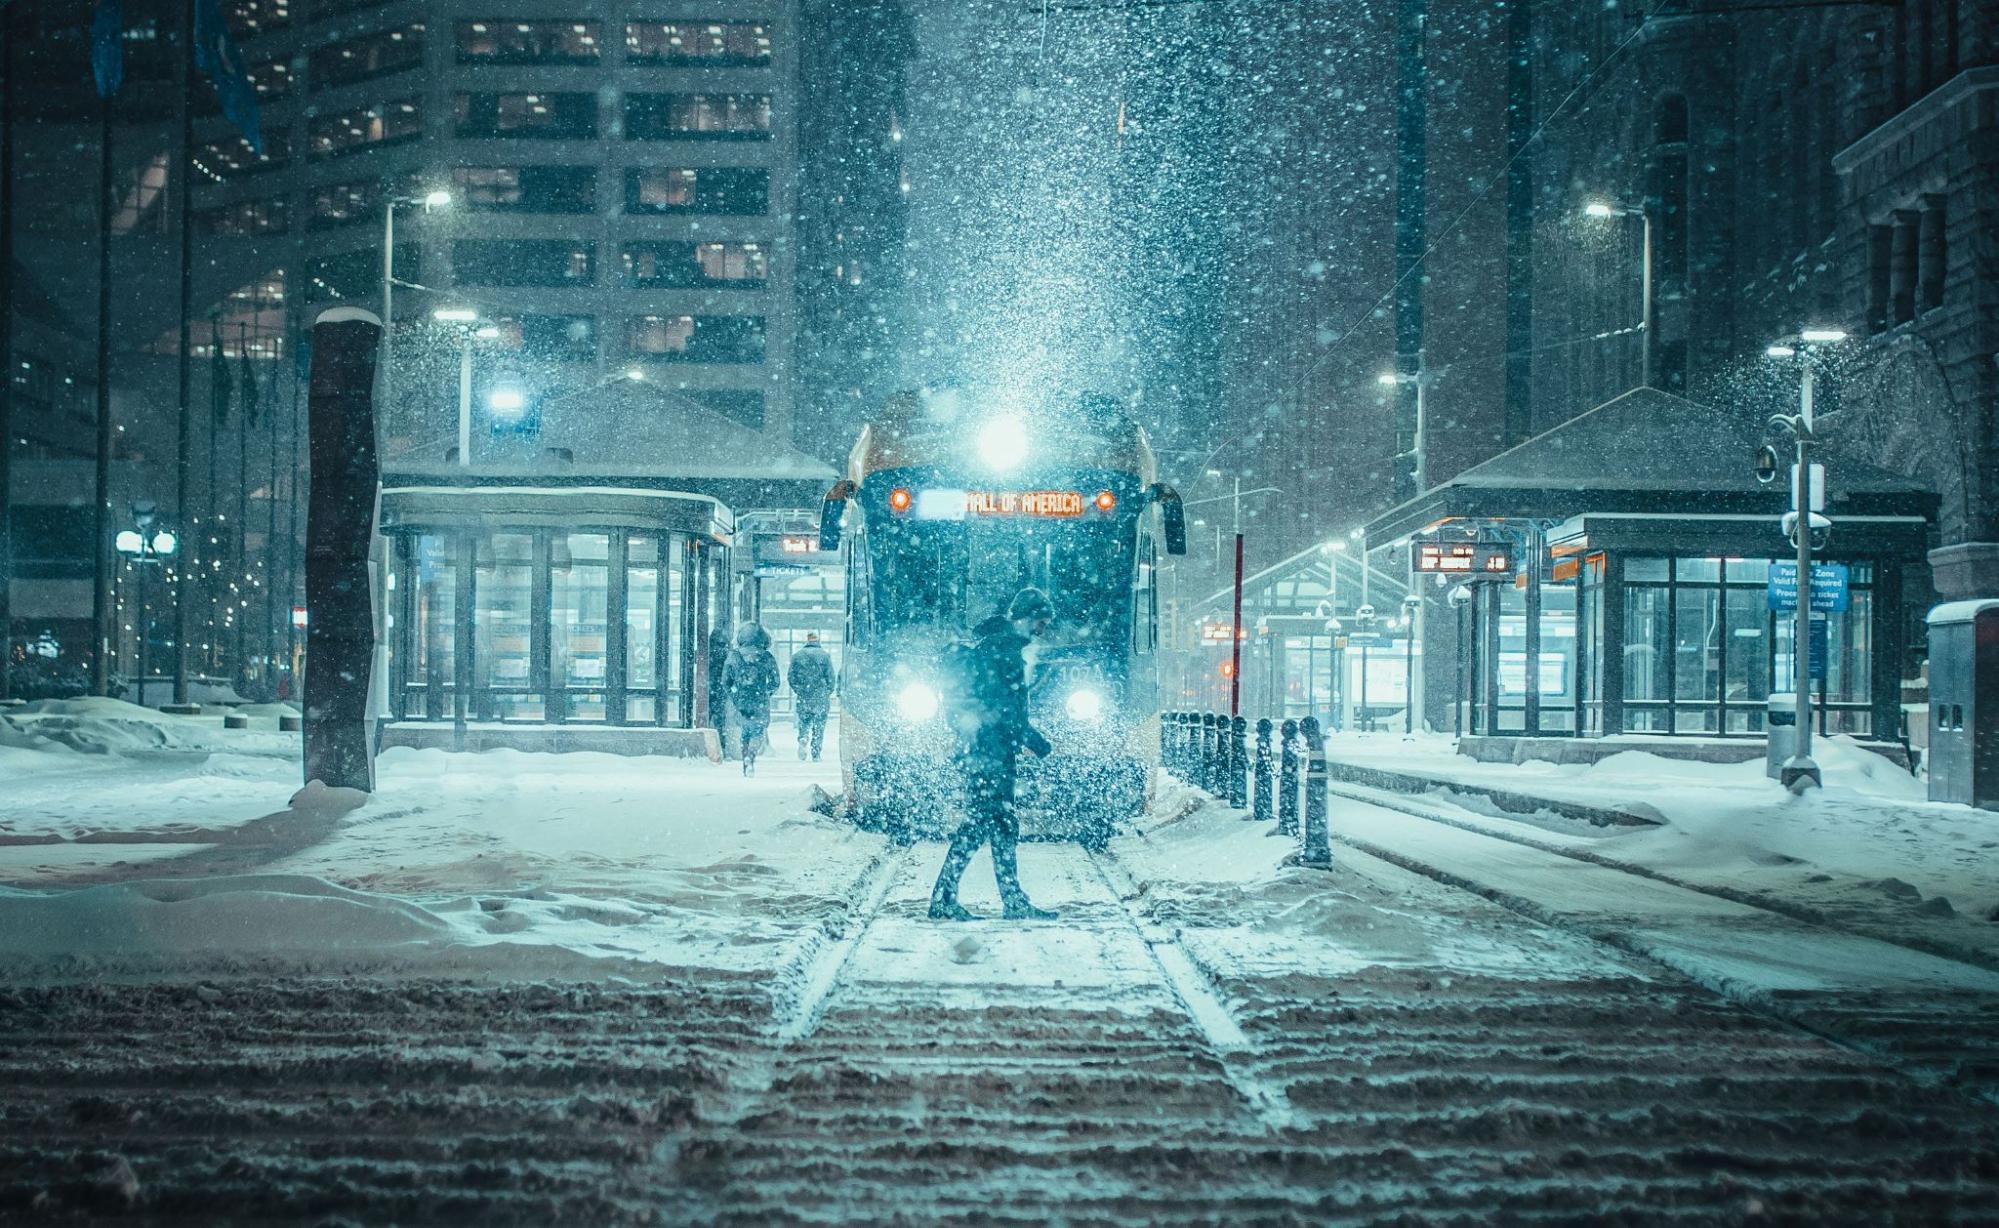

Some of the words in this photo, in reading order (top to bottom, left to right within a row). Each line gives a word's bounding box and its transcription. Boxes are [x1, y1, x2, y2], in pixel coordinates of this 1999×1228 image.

[1001, 492, 1018, 512] OF
[1022, 492, 1081, 513] AMERICA
[772, 567, 805, 576] TICKETS
[1781, 567, 1797, 577] Paid
[1815, 568, 1835, 578] Zone
[1772, 576, 1791, 585] Valid
[1818, 590, 1839, 599] ticket
[1812, 599, 1834, 607] ahead
